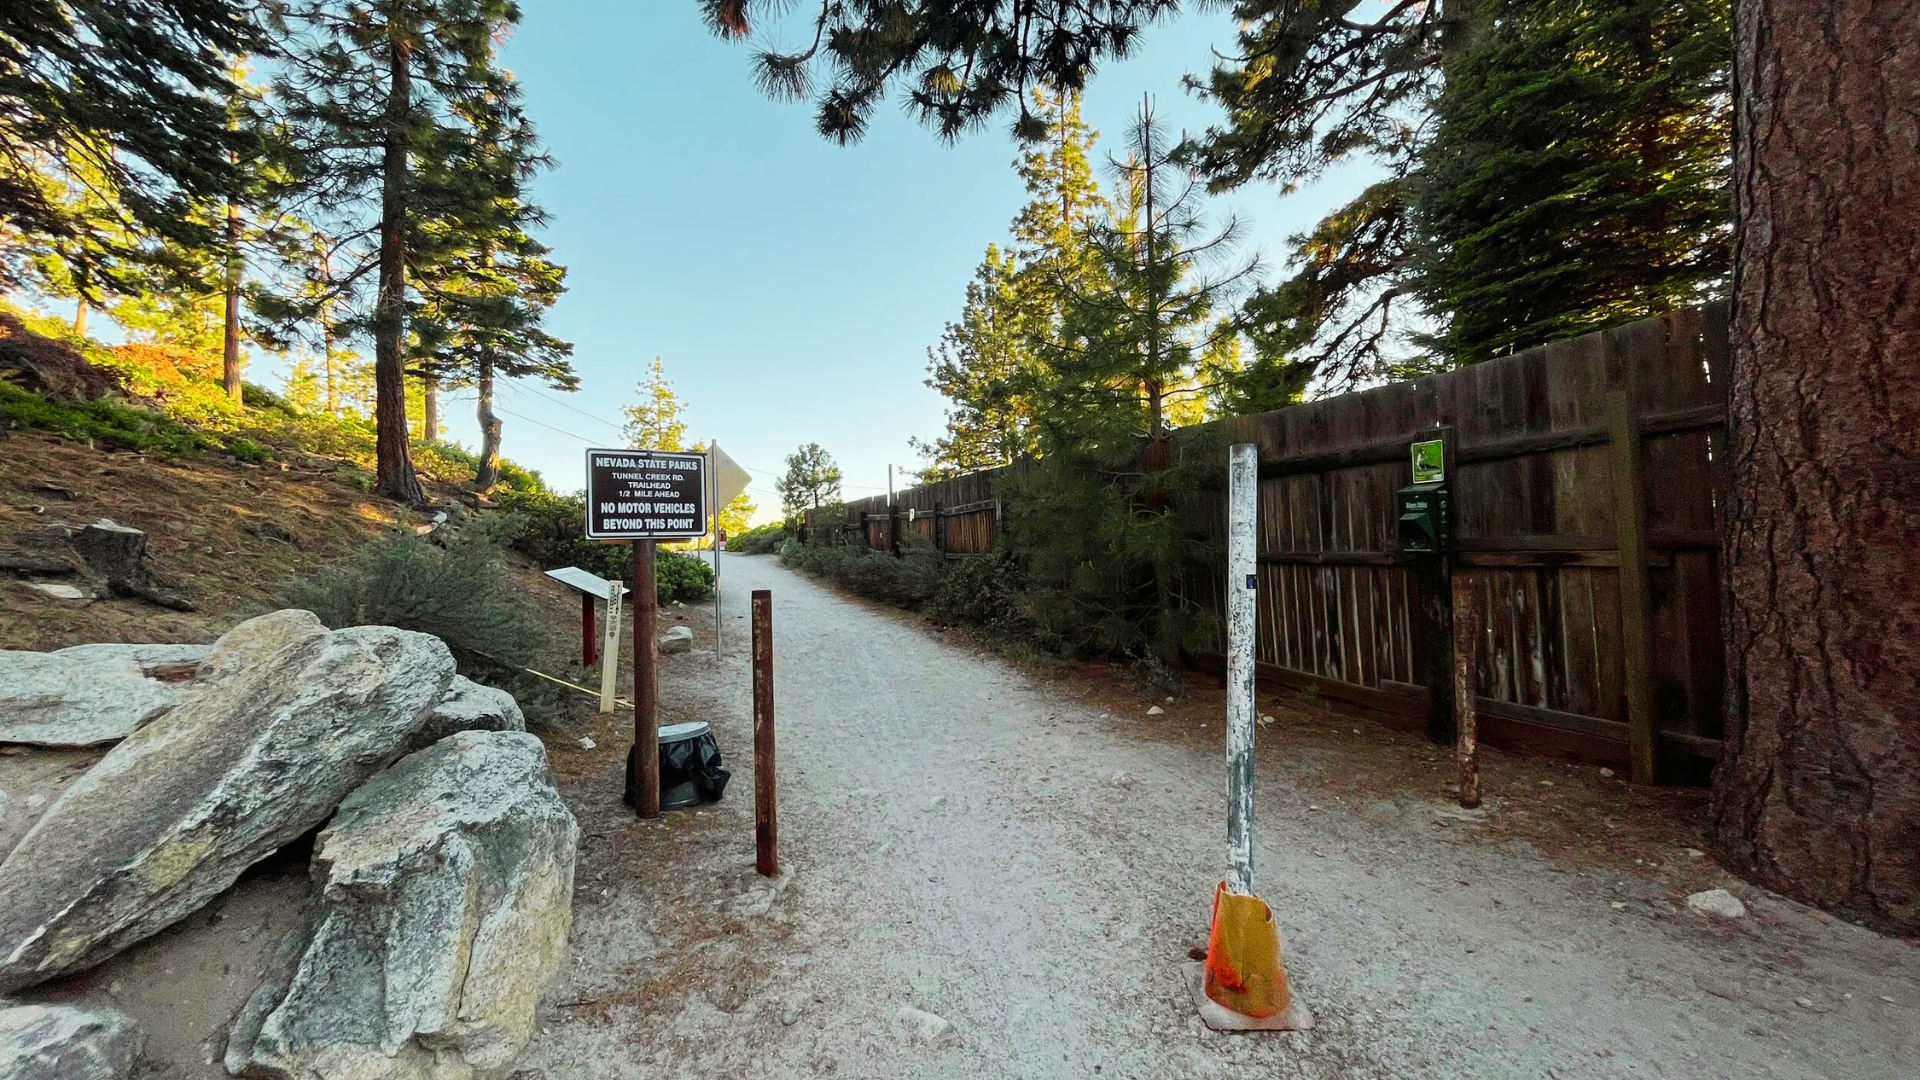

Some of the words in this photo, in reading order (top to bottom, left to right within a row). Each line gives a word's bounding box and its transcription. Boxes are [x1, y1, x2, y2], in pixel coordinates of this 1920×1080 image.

[596, 457, 636, 468] NEVADA
[638, 459, 667, 469] STATE
[669, 460, 698, 471] PARKS
[612, 472, 644, 480] TUNNEL
[645, 473, 671, 481] CREEK
[628, 481, 671, 489] TRAILHEAD
[601, 502, 616, 514] NO
[617, 502, 652, 514] MOTOR
[653, 502, 696, 514] VEHICLES
[603, 518, 643, 530] BEYOND
[644, 518, 666, 530] THIS
[667, 518, 694, 529] POINT
